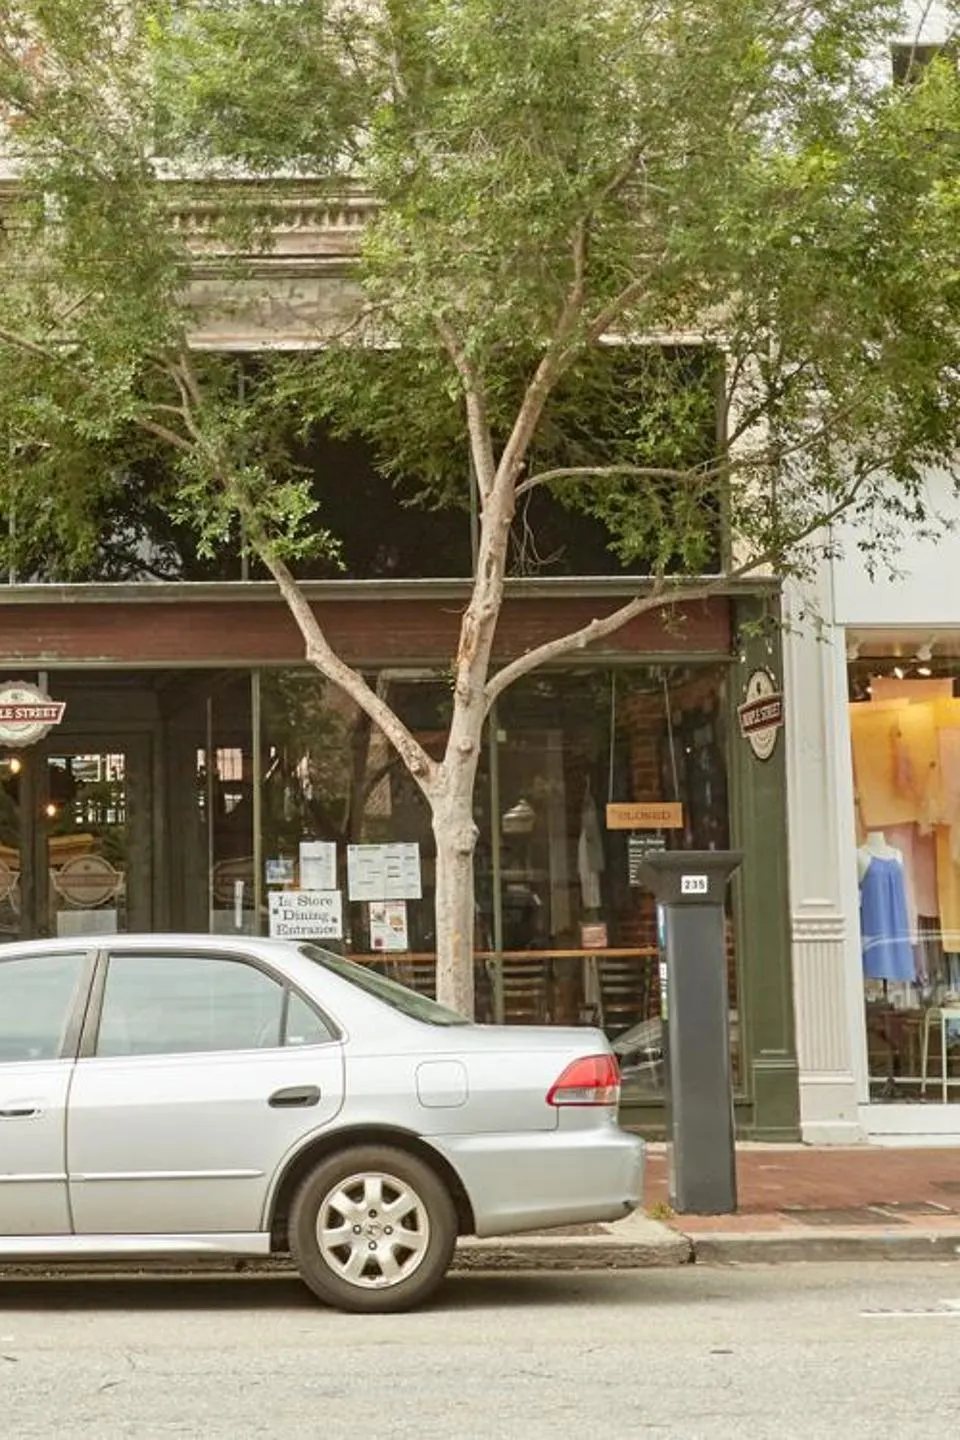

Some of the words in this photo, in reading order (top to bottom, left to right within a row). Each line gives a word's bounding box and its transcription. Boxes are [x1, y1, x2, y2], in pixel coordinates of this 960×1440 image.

[15, 707, 58, 718] STREET
[684, 879, 706, 890] 235
[297, 895, 333, 907] Store
[283, 910, 329, 923] Dining
[276, 924, 337, 935] Entrance
